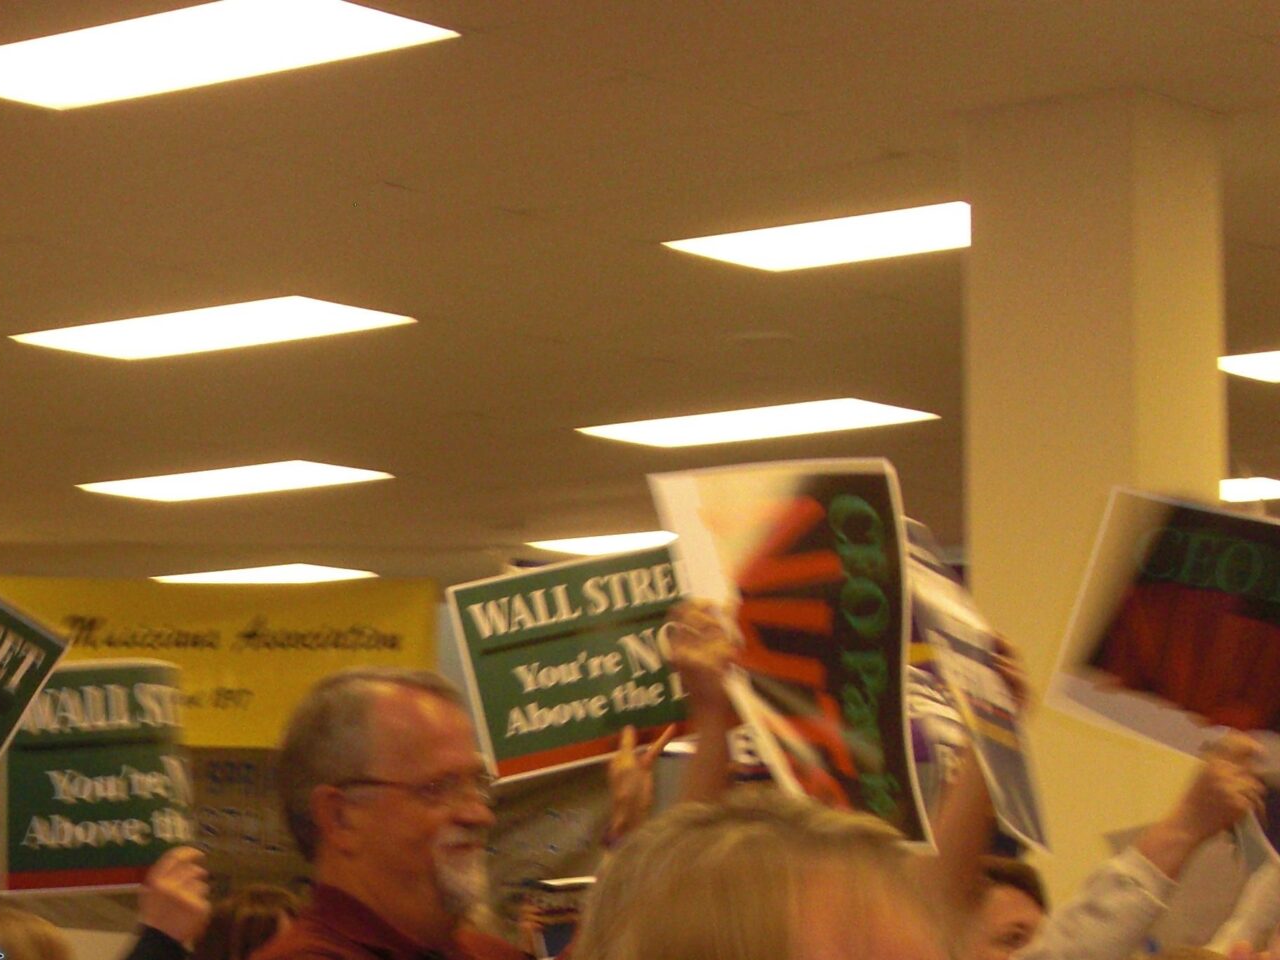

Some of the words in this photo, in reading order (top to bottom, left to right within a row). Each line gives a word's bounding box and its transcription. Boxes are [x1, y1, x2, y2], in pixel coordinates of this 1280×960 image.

[466, 584, 583, 640] WALL
[582, 562, 682, 616] STRE
[512, 650, 623, 694] You're
[505, 694, 609, 739] Above
[612, 679, 666, 713] the
[45, 764, 170, 804] You're
[21, 814, 151, 850] Above
